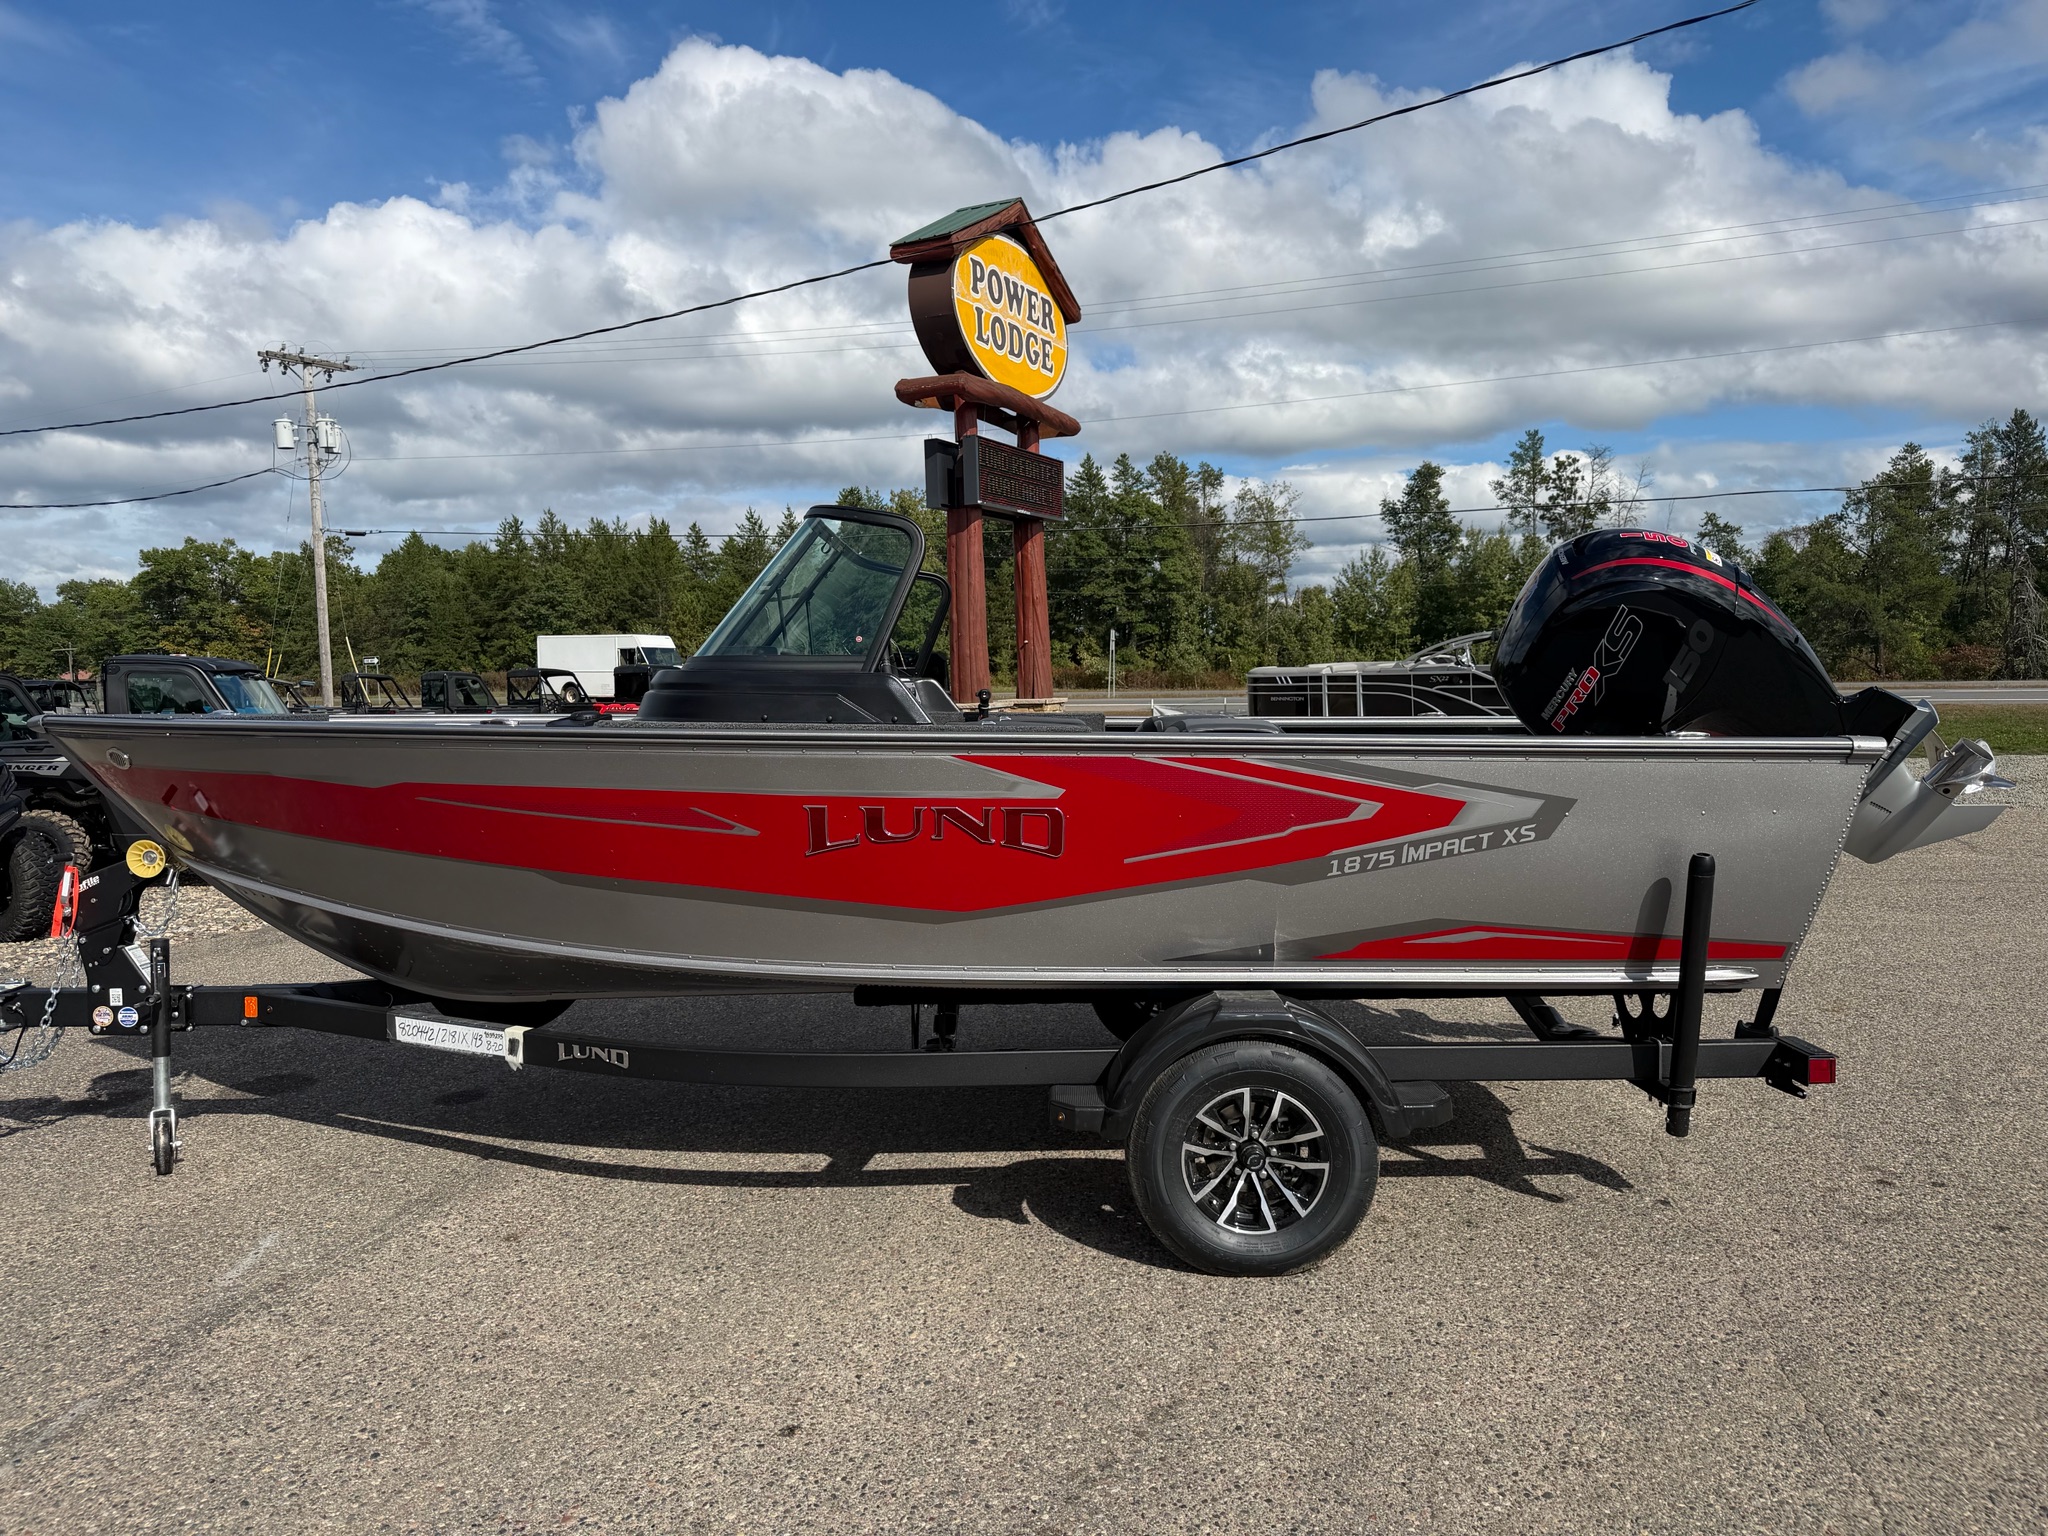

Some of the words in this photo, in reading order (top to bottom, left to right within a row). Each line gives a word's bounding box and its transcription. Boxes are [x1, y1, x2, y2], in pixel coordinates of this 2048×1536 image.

[969, 256, 1055, 335] POWER
[974, 305, 1054, 374] LODGE
[1011, 455, 1058, 485] REBATES
[1620, 531, 1688, 547] 150
[1551, 665, 1600, 733] PRO
[1595, 603, 1643, 706] XS
[1662, 618, 1714, 694] 150
[1541, 667, 1578, 720] MERCURY
[802, 804, 1065, 858] LUND
[1327, 850, 1396, 876] 1875
[1401, 832, 1494, 864] IMPACT
[1502, 823, 1537, 846] XS
[486, 1040, 504, 1052] 8-20
[557, 1042, 630, 1069] LUND
